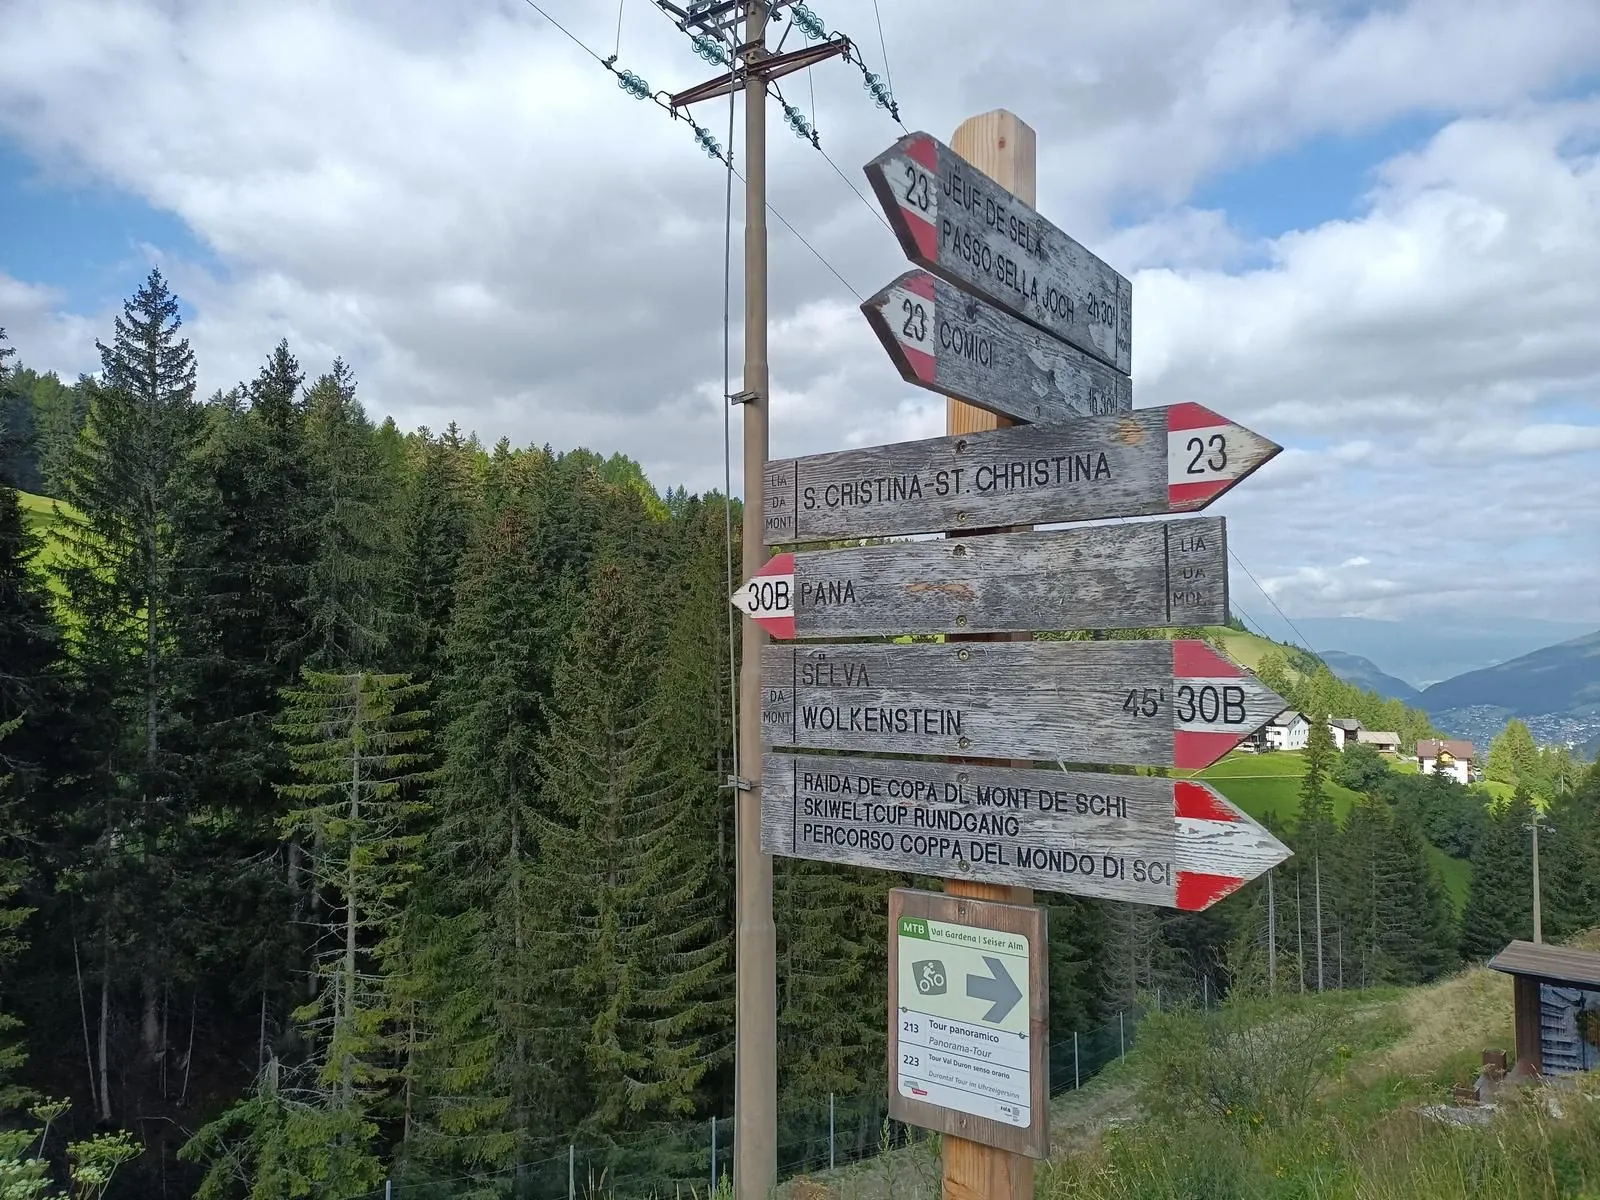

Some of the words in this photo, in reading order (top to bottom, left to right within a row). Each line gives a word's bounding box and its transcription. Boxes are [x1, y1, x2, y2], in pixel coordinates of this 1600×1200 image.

[905, 166, 929, 212] 23
[943, 164, 982, 216] JËUF
[986, 197, 1005, 235] DE
[1009, 215, 1042, 260] SELA
[943, 220, 992, 272] PASSO
[997, 254, 1038, 300] SELLA
[1042, 290, 1074, 325] JOCH
[902, 299, 925, 342] 23
[940, 320, 993, 369] COMICI
[1186, 434, 1227, 474] 23
[771, 474, 787, 487] LIA
[803, 486, 821, 510] S.
[975, 452, 1112, 492] CHRISTINA
[772, 496, 786, 509] DA
[765, 516, 792, 530] MONT
[1181, 536, 1207, 552] LIA
[748, 581, 789, 612] 30B
[801, 579, 856, 606] PANA
[1173, 591, 1206, 608] MON
[802, 653, 870, 687] SËLVA
[770, 690, 785, 702] DA
[1176, 685, 1247, 725] 30B
[763, 711, 791, 724] MONT
[803, 706, 962, 735] WOLKENSTEIN
[1122, 688, 1166, 719] 45'
[804, 773, 851, 793] RAIDA
[858, 776, 881, 796] DE
[888, 779, 938, 801] COPA
[945, 783, 969, 804] DL
[977, 785, 1031, 809] MONT
[1038, 790, 1068, 812] DE
[1076, 793, 1127, 818] SCHI
[804, 798, 907, 825] SKIWELTCUP
[914, 807, 1019, 837] RUNDGANG
[803, 823, 894, 851] PERCORSO
[901, 834, 963, 860] COPPA
[970, 841, 1010, 866] DEL
[1017, 846, 1095, 875] MONDO
[1103, 856, 1124, 880] DI
[1132, 859, 1171, 886] SCI
[902, 922, 925, 935] MTB
[930, 927, 944, 938] Val
[945, 930, 977, 943] Gardena
[983, 936, 1006, 949] Seiser
[1008, 940, 1024, 951] Alm
[904, 1022, 919, 1033] 213
[929, 1019, 947, 1031] Tour
[949, 1025, 1000, 1043] panoramico
[929, 1036, 992, 1058] Panorama-Tour
[904, 1055, 919, 1067] 223
[929, 1053, 942, 1062] Tour
[943, 1056, 952, 1065] Val
[953, 1059, 972, 1070] Duron
[973, 1065, 990, 1074] senso
[992, 1070, 1010, 1079] orario
[955, 1074, 968, 1085] Tour
[969, 1080, 977, 1088] im
